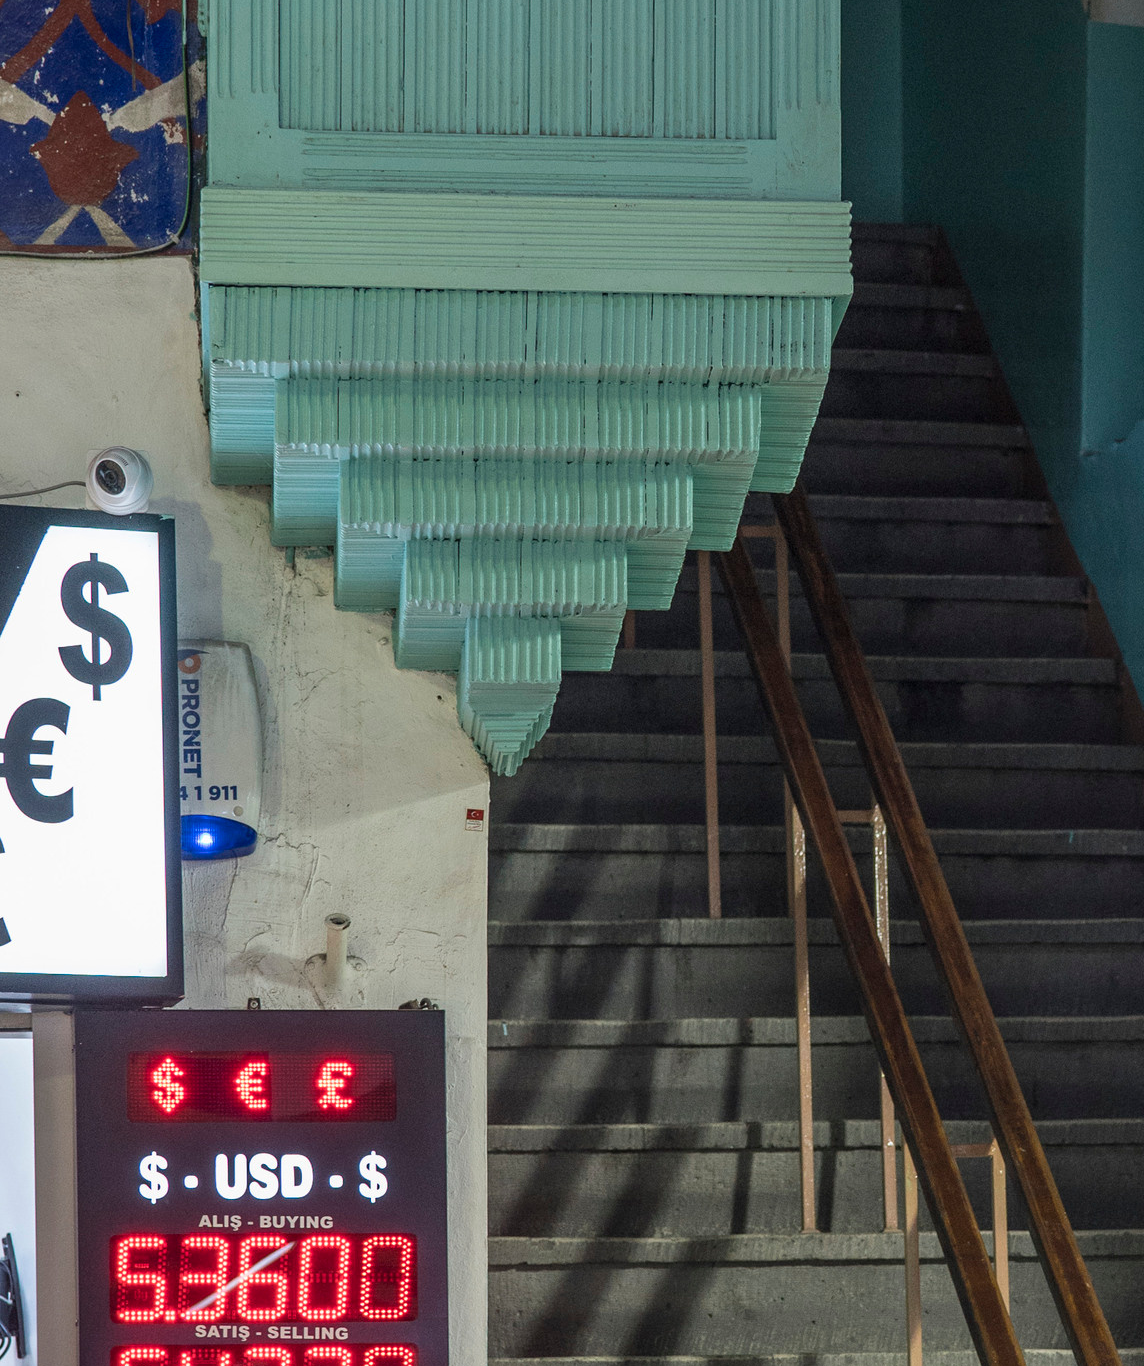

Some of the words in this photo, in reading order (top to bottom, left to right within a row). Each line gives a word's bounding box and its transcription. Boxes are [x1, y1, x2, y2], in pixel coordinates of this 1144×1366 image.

[58, 552, 134, 701] $
[181, 678, 203, 778] PRONET
[0, 697, 75, 824] €
[208, 785, 239, 801] 911
[152, 1057, 185, 1114] $
[235, 1061, 268, 1110] €
[317, 1061, 353, 1110] £
[138, 1150, 169, 1205] $
[214, 1152, 314, 1201] USD
[358, 1149, 389, 1204] $
[198, 1214, 242, 1232] ALIŞ
[259, 1215, 335, 1229] BUYING
[116, 1234, 413, 1322] 5.3600
[194, 1324, 250, 1342] SATIŞ
[266, 1326, 349, 1341] SELLING
